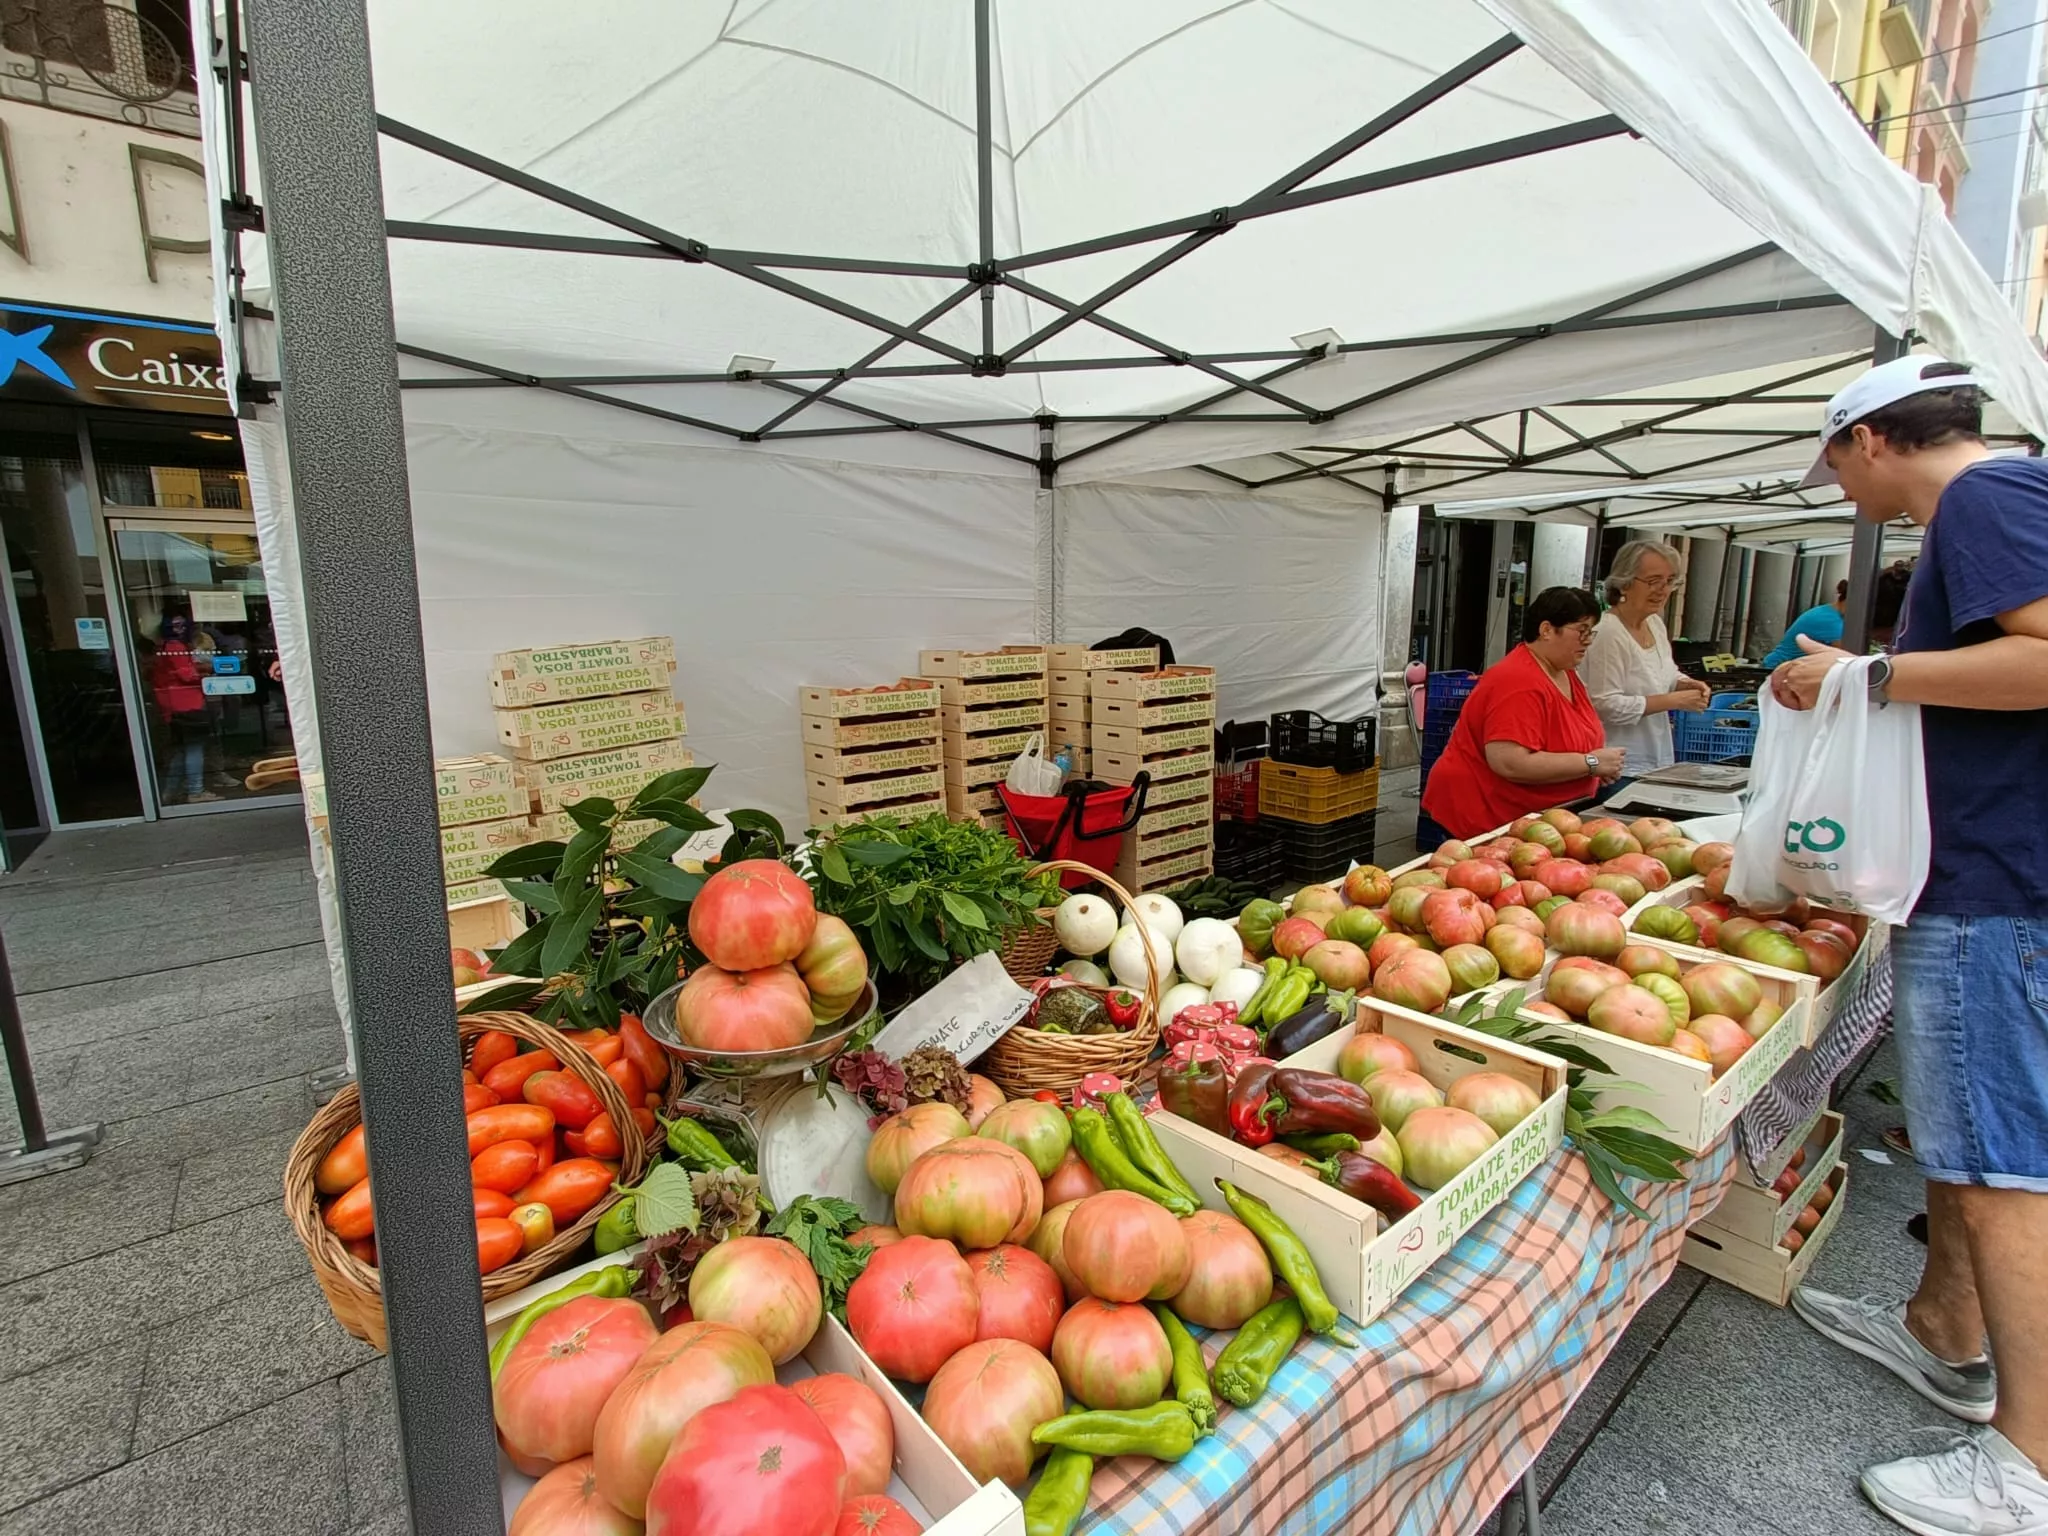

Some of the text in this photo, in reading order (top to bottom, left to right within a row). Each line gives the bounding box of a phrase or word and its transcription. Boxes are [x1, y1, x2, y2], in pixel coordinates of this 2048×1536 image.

[532, 646, 612, 663] BARBASTRO
[986, 657, 1016, 666] TOMATE
[534, 655, 632, 674] TOMATE ROSA
[555, 668, 650, 686] TOMATE ROSA
[576, 678, 652, 695] BARBASTRO
[864, 692, 928, 704] TOMATE ROSA
[876, 700, 929, 712] BARBASTRO
[536, 700, 615, 719] BARBASTRO
[539, 709, 634, 730] TOMATE ROSA
[866, 720, 930, 734] TOMATE ROSA
[578, 718, 669, 739] TOMATE ROSA
[598, 729, 671, 746] BARBASTRO
[545, 752, 622, 773] BARBASTRO
[868, 748, 930, 763] TOMATE ROSA
[547, 760, 642, 784] TOMATE ROSA
[586, 774, 641, 791] TOMATE
[464, 794, 506, 808] ROSA
[1436, 1112, 1548, 1222] TOMATE ROSA
[1437, 1136, 1547, 1246] DE BARBASTRO
